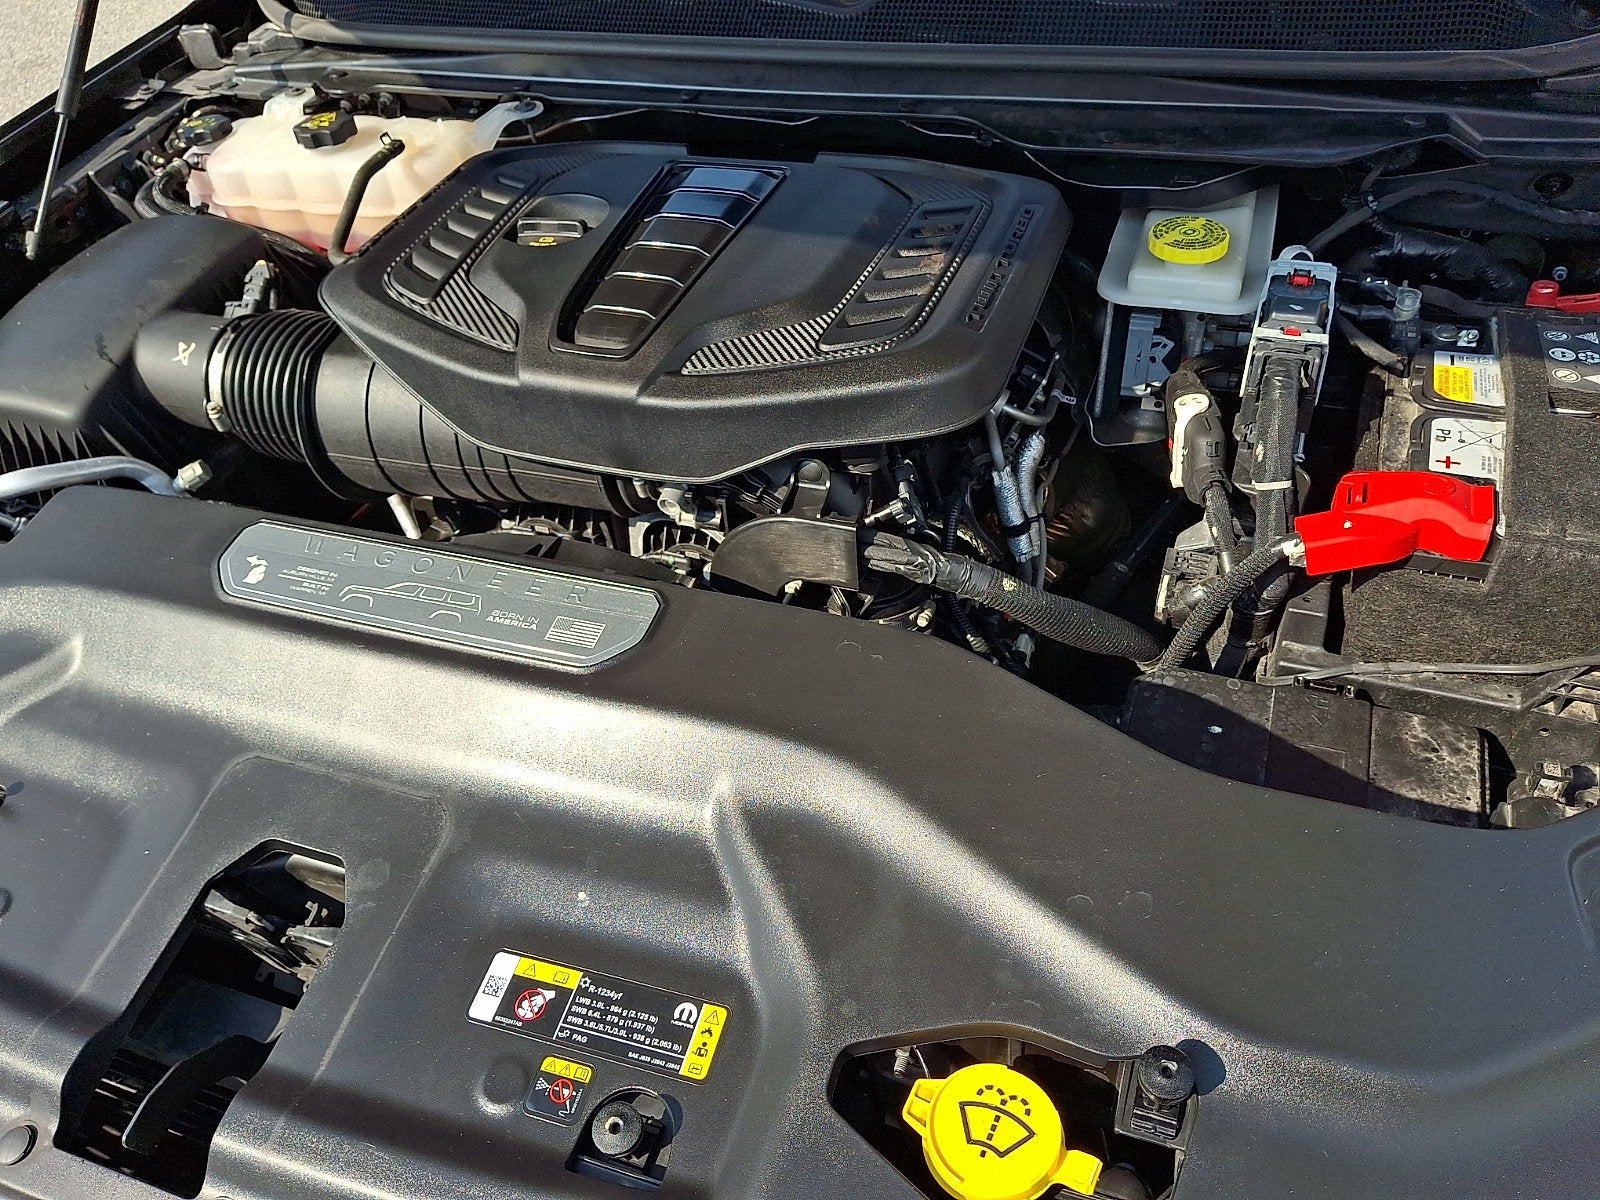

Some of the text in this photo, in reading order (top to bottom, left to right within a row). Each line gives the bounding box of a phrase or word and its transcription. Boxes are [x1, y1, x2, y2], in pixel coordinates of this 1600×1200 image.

[303, 536, 592, 604] WAGONEER
[485, 615, 537, 631] AMERICA
[492, 609, 540, 624] BORN IN
[587, 984, 623, 1001] R-1234yf
[575, 995, 591, 1006] LWB
[628, 1009, 649, 1021] (2.125
[566, 1015, 583, 1026] SWB
[571, 1005, 587, 1016] SWB
[624, 1019, 646, 1032] (1.937
[571, 1033, 588, 1043] PAG
